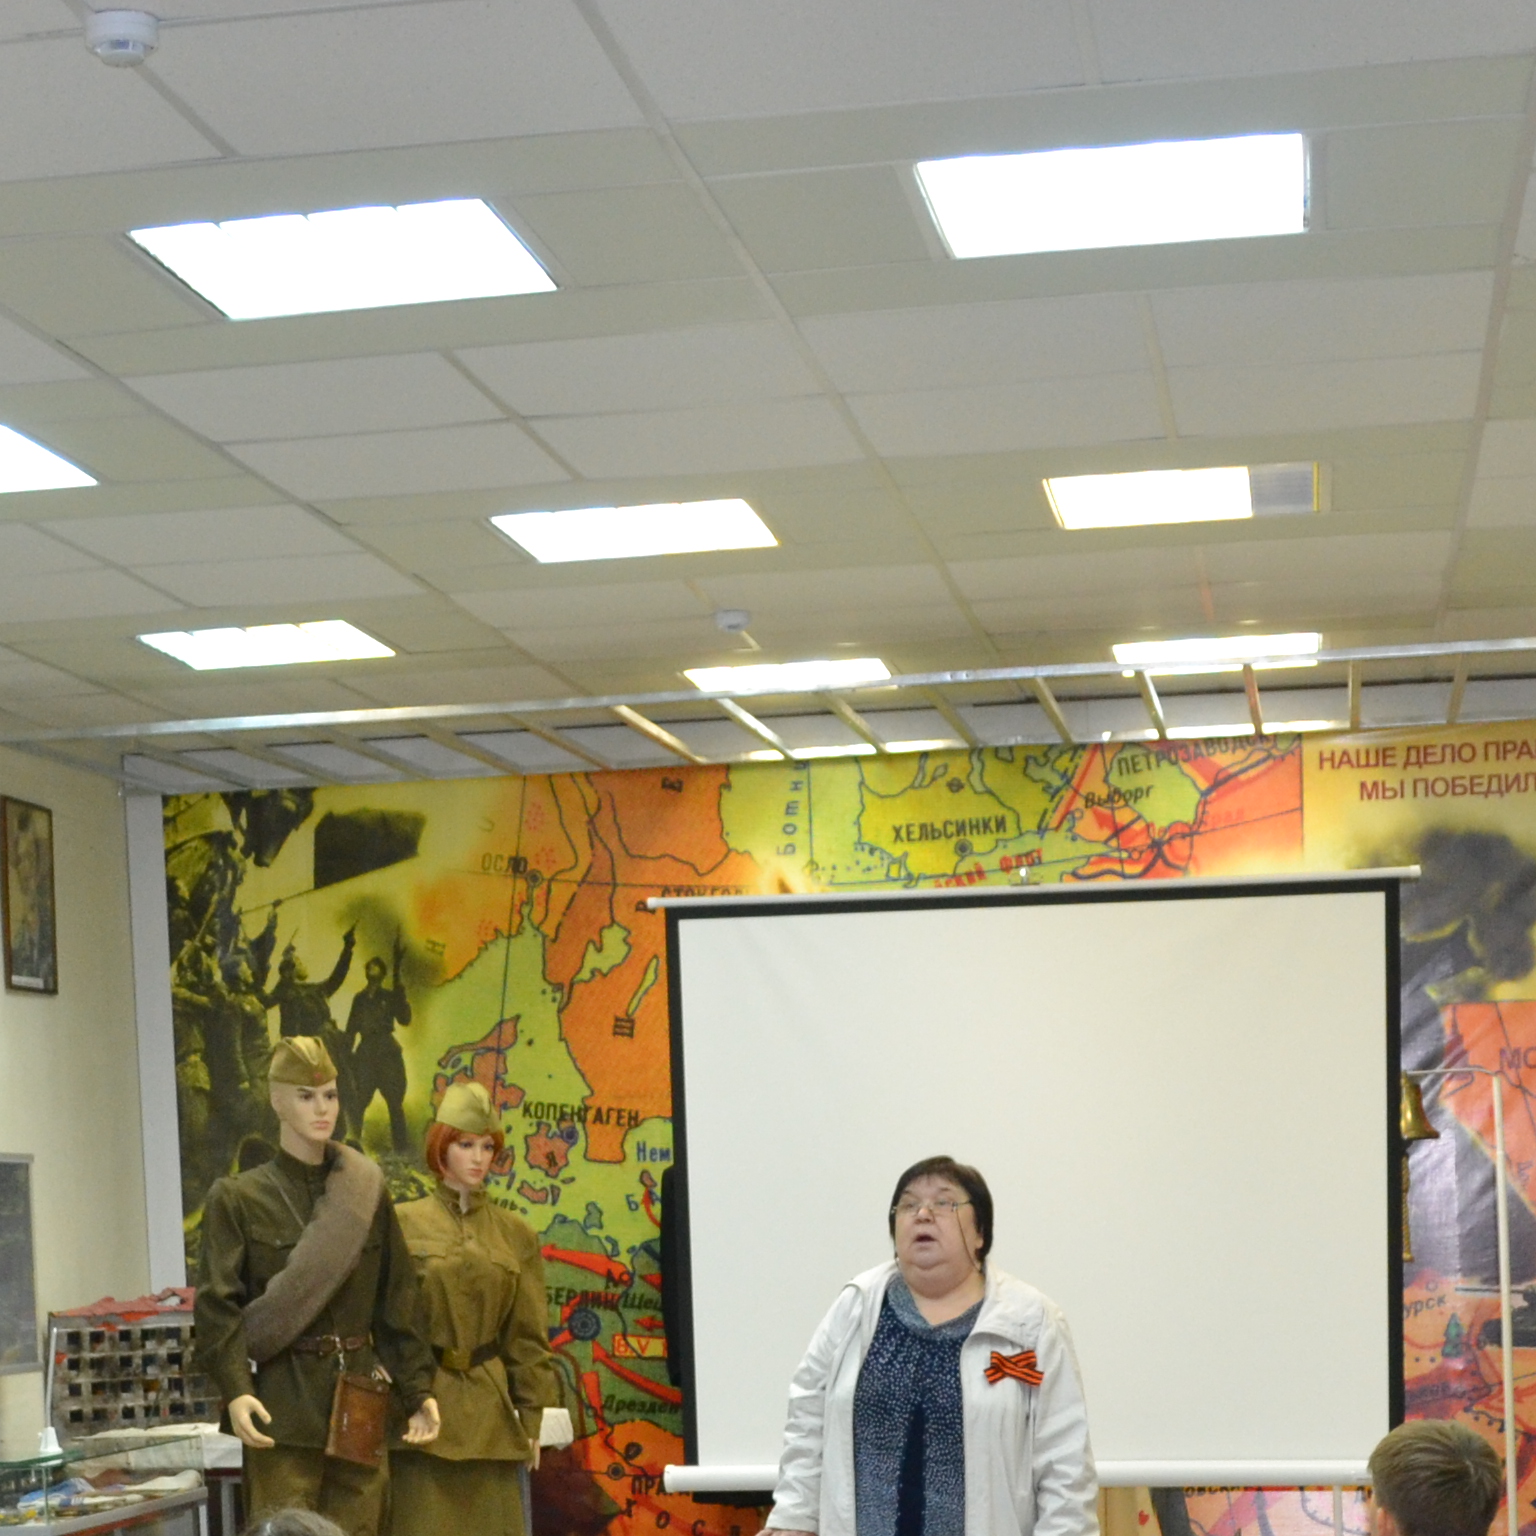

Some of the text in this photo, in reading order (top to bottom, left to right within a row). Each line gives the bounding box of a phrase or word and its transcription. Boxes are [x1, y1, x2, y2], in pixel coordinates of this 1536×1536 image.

[1318, 746, 1397, 770] НАШЕ
[1403, 743, 1477, 770] ДЕЛО
[1085, 784, 1154, 809] Выборг
[1359, 779, 1405, 801] МЫ
[892, 814, 1008, 844] ХЕЛЬСИНКИ
[480, 852, 529, 874] ОСЛО
[522, 1101, 641, 1128] КОПЕНГАГЕН
